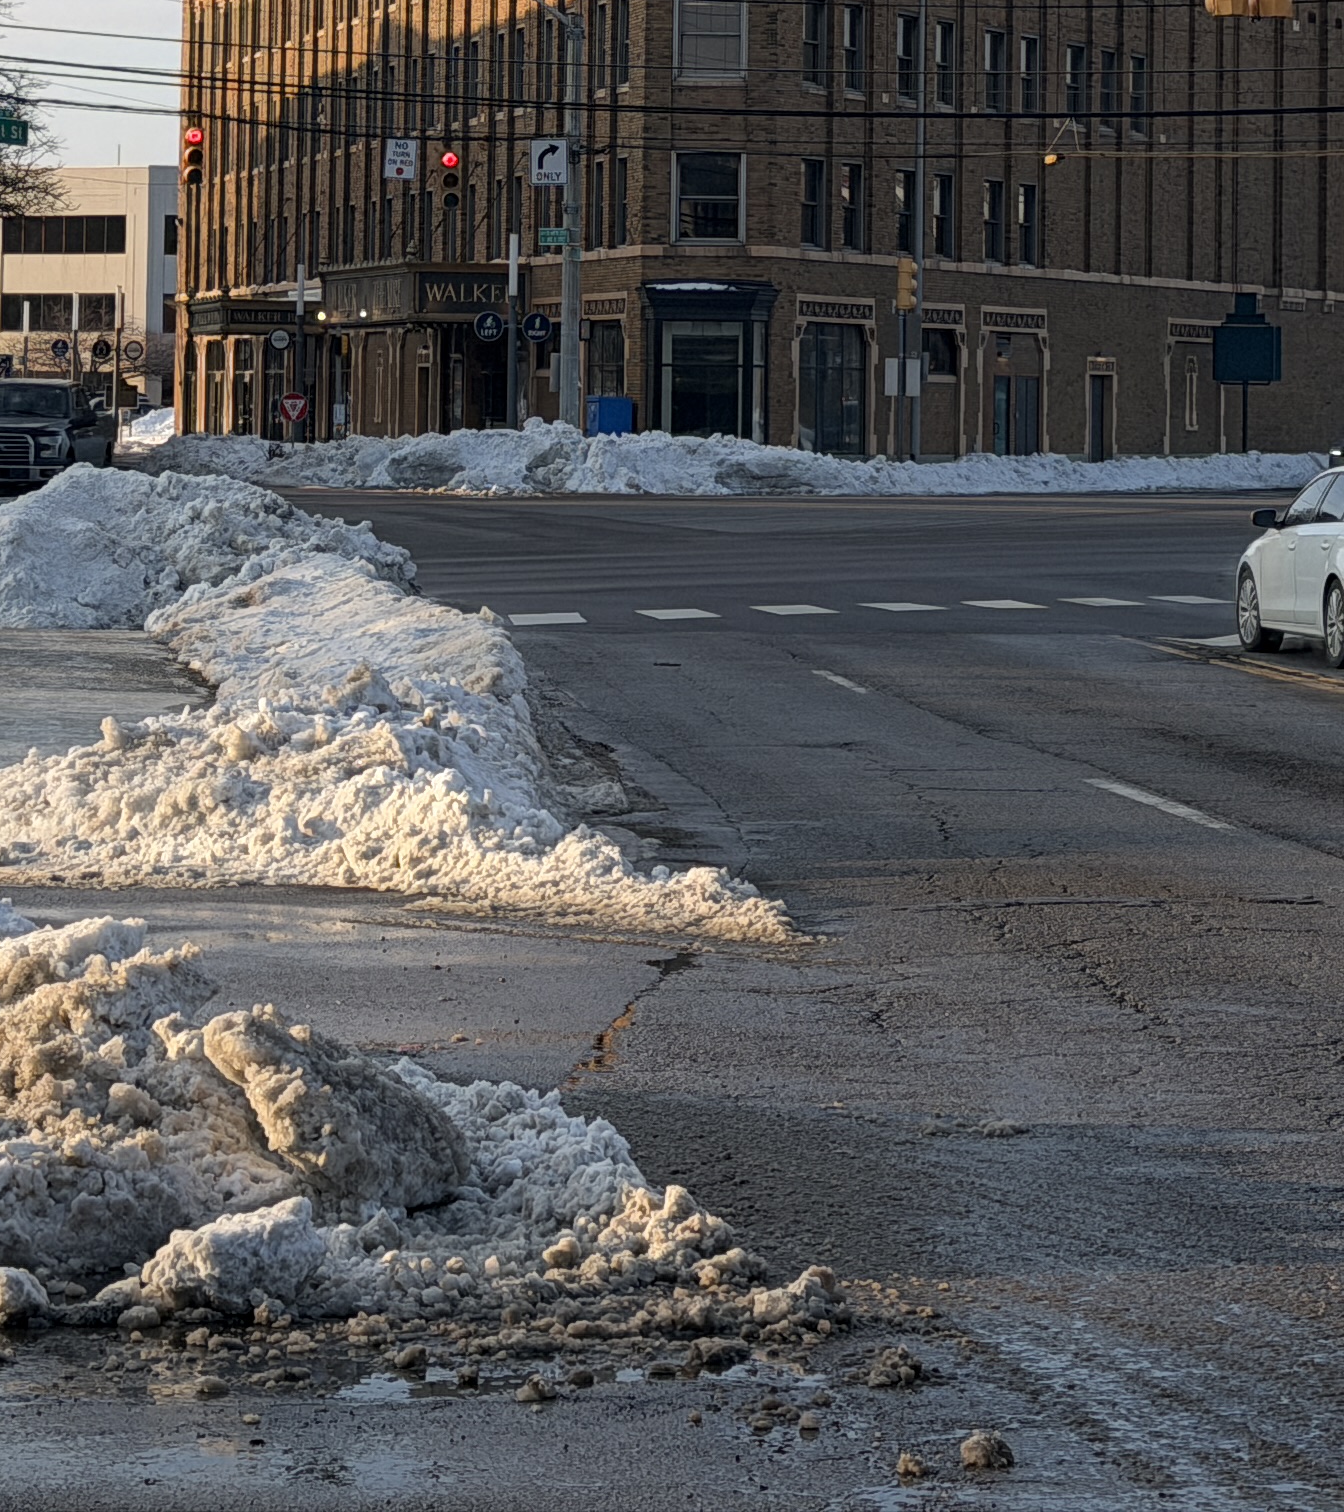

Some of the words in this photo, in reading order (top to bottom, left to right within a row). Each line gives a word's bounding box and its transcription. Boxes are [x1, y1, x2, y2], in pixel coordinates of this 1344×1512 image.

[10, 125, 23, 140] St
[395, 141, 409, 150] NO
[392, 150, 410, 158] TURN
[400, 159, 413, 167] RED
[536, 171, 562, 182] ONLY
[425, 282, 509, 304] WALKE
[481, 328, 497, 337] LEFT
[528, 330, 546, 338] RIGHT
